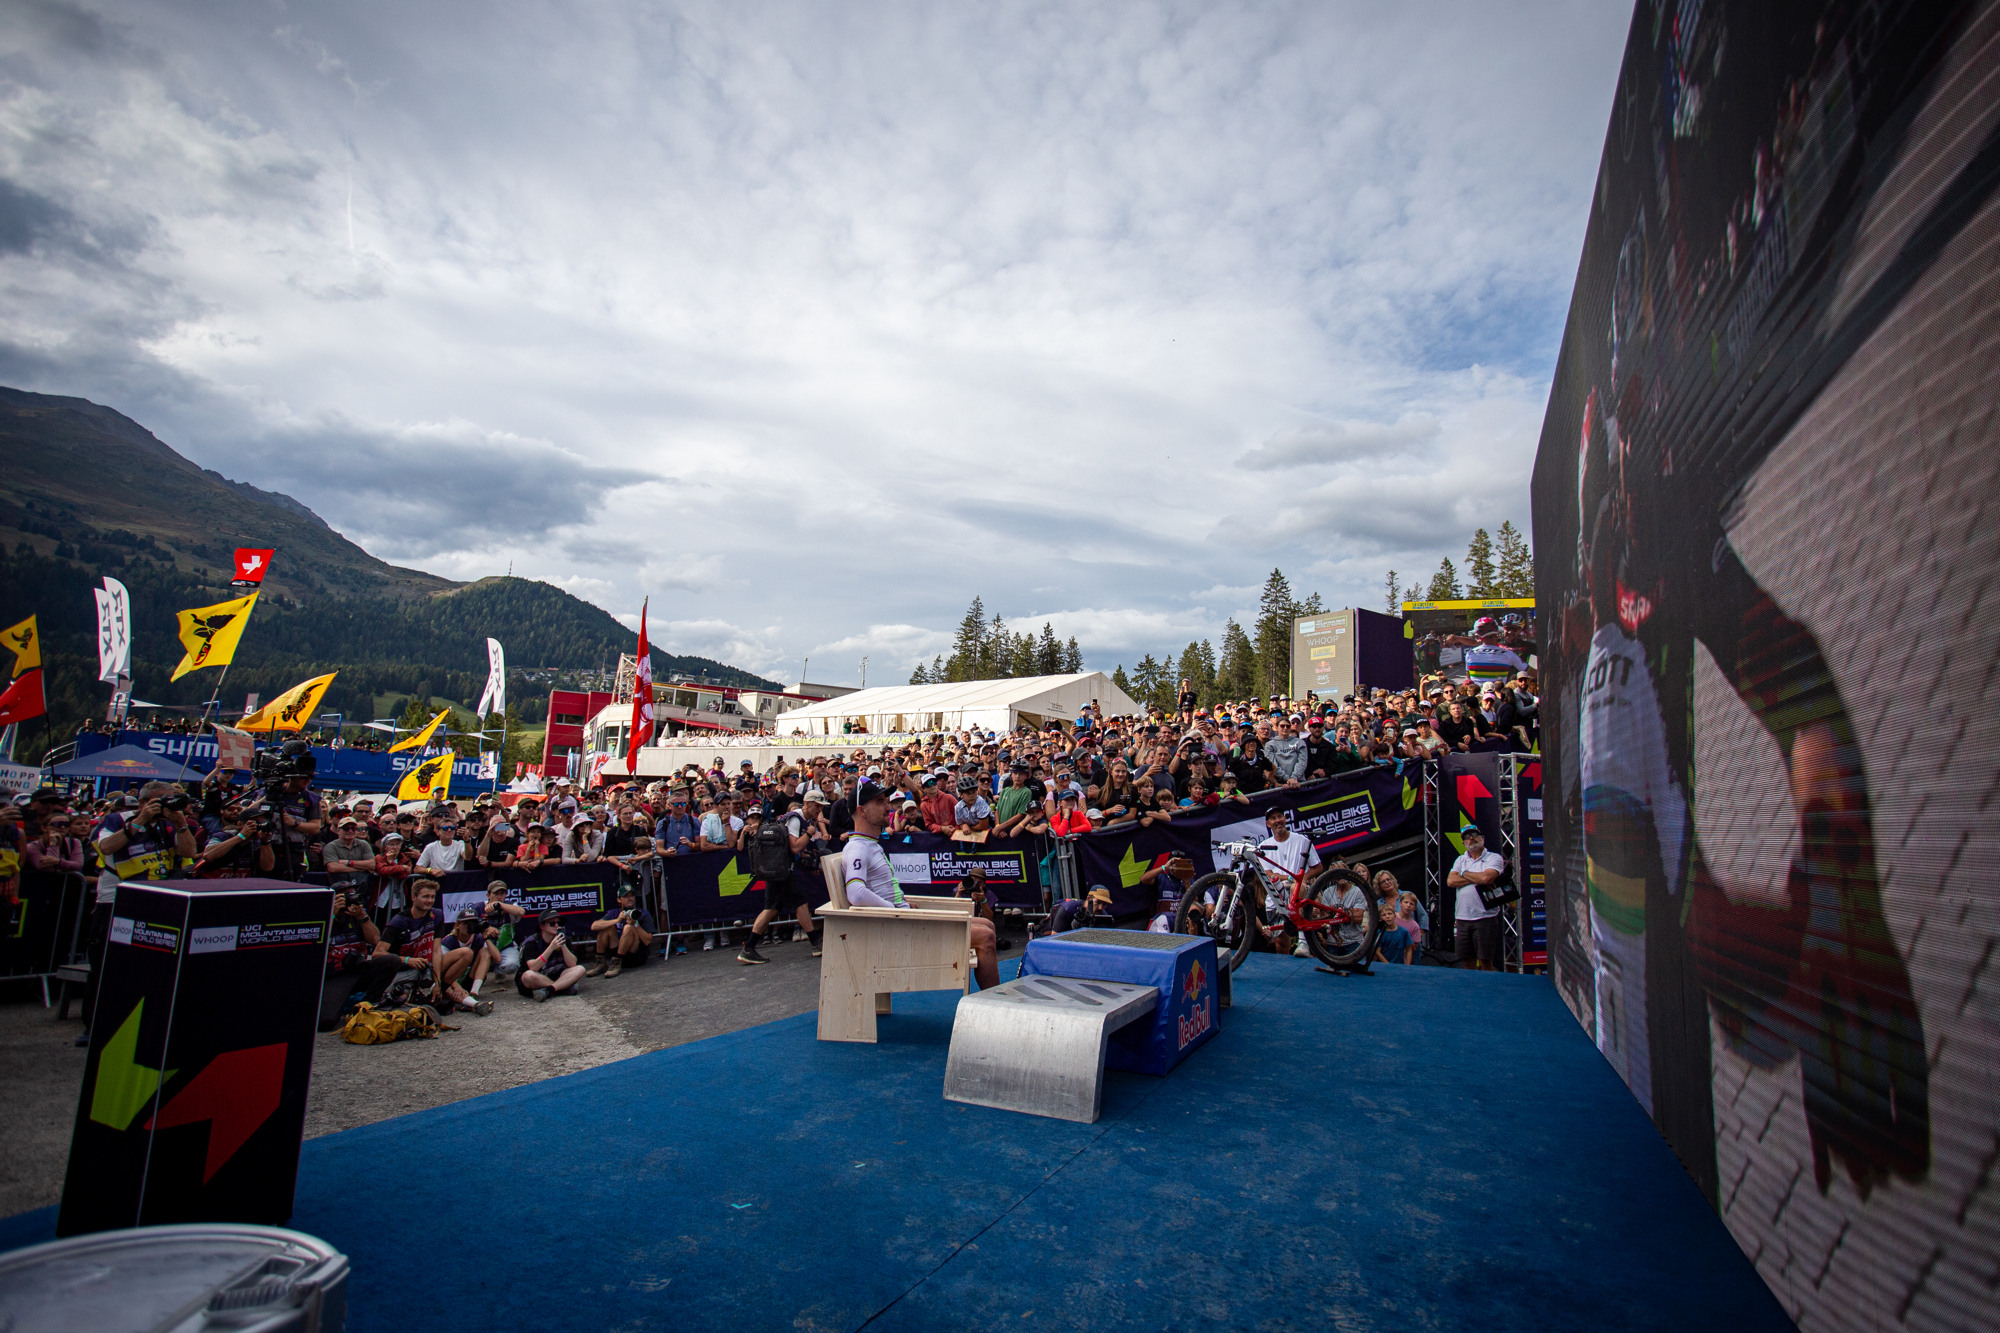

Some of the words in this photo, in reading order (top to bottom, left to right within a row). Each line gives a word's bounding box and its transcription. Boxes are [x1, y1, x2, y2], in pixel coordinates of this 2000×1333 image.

[1307, 635, 1339, 646] WHOOP
[148, 738, 219, 758] SHIM
[1283, 809, 1295, 822] CI
[1286, 811, 1339, 832] OUNTAIN
[1341, 803, 1370, 819] BIKE
[1326, 813, 1371, 835] SERIES
[934, 852, 953, 861] UCI
[893, 864, 927, 873] WHOOP
[931, 861, 989, 869] MOUNTAIN
[991, 860, 1019, 868] BIKE
[985, 868, 1020, 876] ERIES
[505, 894, 565, 904] OUNTAIN
[568, 891, 598, 900] BIKE
[521, 902, 548, 911] RLD
[551, 899, 598, 909] SERIES
[113, 925, 132, 936] WHOOP
[133, 927, 163, 938] MOUNTAIN
[163, 932, 177, 941] BIKE
[240, 929, 296, 938] MOUNTAIN
[297, 927, 321, 935] BIKE
[244, 924, 262, 932] UCI
[133, 934, 154, 943] WORLD
[154, 938, 176, 948] SERIES
[194, 935, 235, 945] WHOOP
[240, 935, 280, 945] WORLD
[283, 932, 320, 942] SERIES
[1178, 1004, 1196, 1051] Red
[1195, 994, 1211, 1038] Bull
